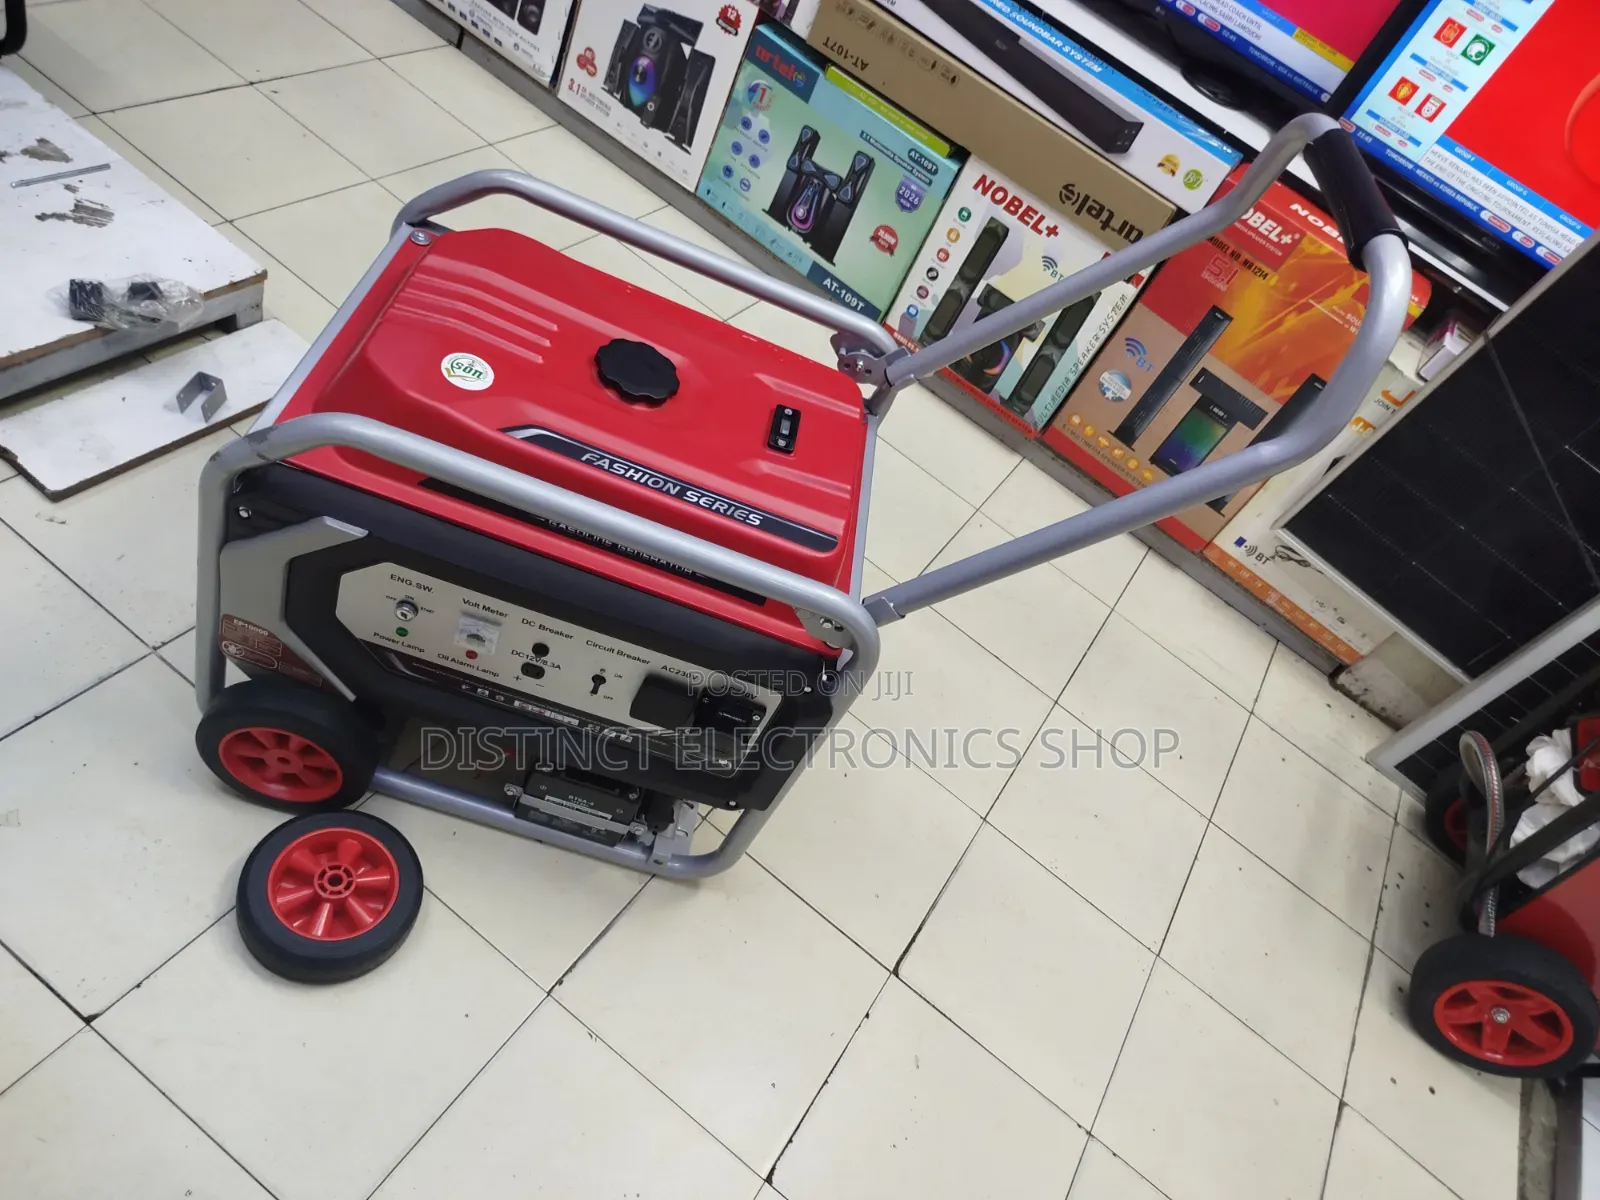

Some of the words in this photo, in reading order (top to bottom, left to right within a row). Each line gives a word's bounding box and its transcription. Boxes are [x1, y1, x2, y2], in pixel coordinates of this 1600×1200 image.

[1009, 10, 1063, 48] SOUNDBAR
[1061, 43, 1102, 74] SYSTEM
[822, 35, 869, 72] AT-107T
[567, 78, 582, 95] 3.1
[908, 150, 937, 172] AT-109T
[1424, 156, 1434, 166] THE
[1454, 146, 1471, 159] GROUP
[1384, 148, 1413, 170] TOMORROW
[1415, 168, 1434, 183] MEXICO
[1439, 183, 1455, 197] KOREA
[1455, 194, 1478, 212] REPUBLIC
[1506, 179, 1523, 193] GROUP
[898, 186, 920, 205] 2026
[972, 172, 1062, 243] NOBEL+
[1558, 213, 1576, 227] GROUP
[1049, 269, 1064, 282] BT
[1205, 252, 1240, 286] 5.1
[822, 276, 864, 311] AT-109T
[1067, 333, 1101, 377] SPEAKER
[1096, 293, 1128, 335] SYSTEM
[1373, 396, 1391, 411] JOIN
[581, 450, 680, 496] FASHION
[683, 489, 763, 527] SERIES
[1254, 551, 1271, 566] BT
[461, 598, 480, 609] Volt
[481, 604, 508, 618] Meter
[520, 617, 535, 627] DC
[538, 623, 574, 640] Breaker
[373, 632, 399, 645] Power
[400, 641, 425, 654] Lamp
[585, 639, 615, 653] Circuit
[616, 649, 651, 665] Breaker
[436, 652, 448, 661] Oil
[449, 656, 475, 670] Alarm
[475, 665, 499, 678] Lamp
[510, 649, 562, 670] DC12V/8.3A
[660, 664, 698, 681] AC230V
